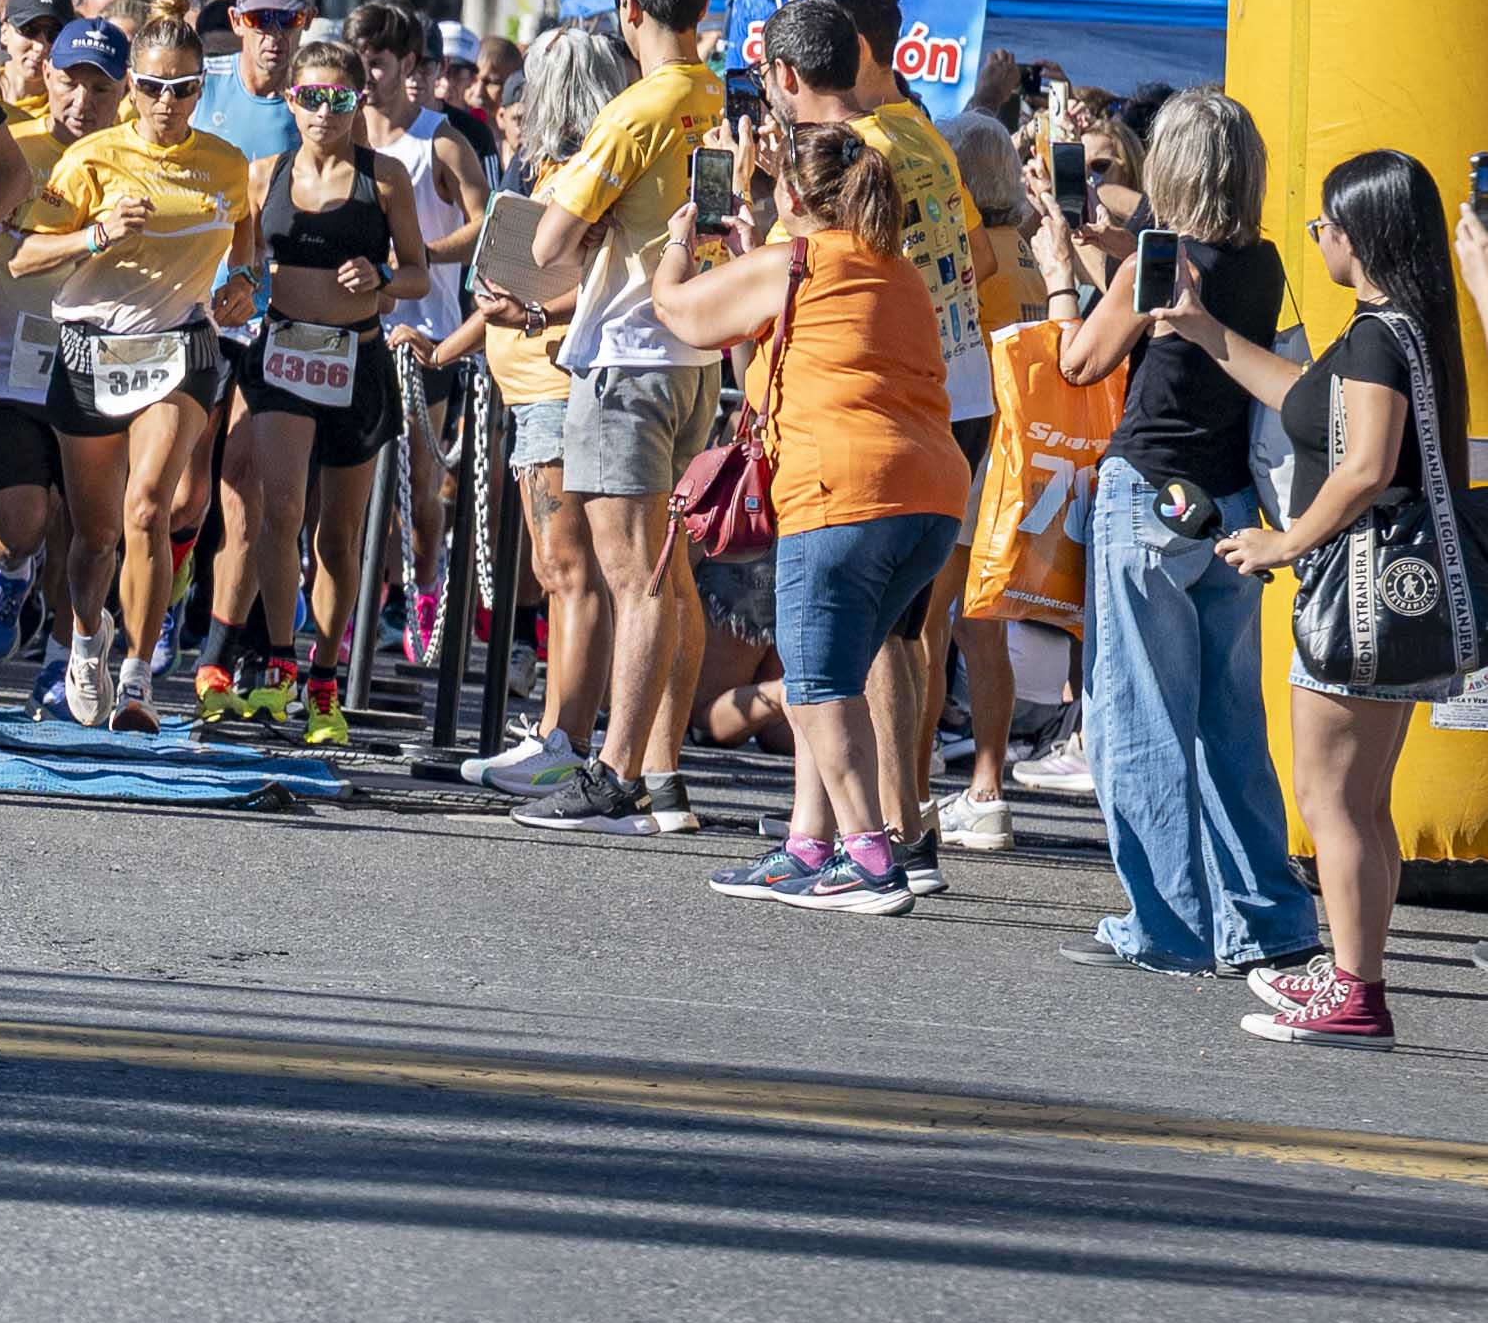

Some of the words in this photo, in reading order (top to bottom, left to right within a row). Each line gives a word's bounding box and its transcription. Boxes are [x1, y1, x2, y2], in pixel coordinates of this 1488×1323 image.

[265, 352, 349, 386] 4366
[1393, 563, 1427, 577] LEGION
[1421, 419, 1446, 506] EXTRANJERA
[1439, 513, 1459, 567] LEGION
[1451, 572, 1474, 662] EXTRANJERA
[1355, 548, 1370, 633] EXTRANJERA
